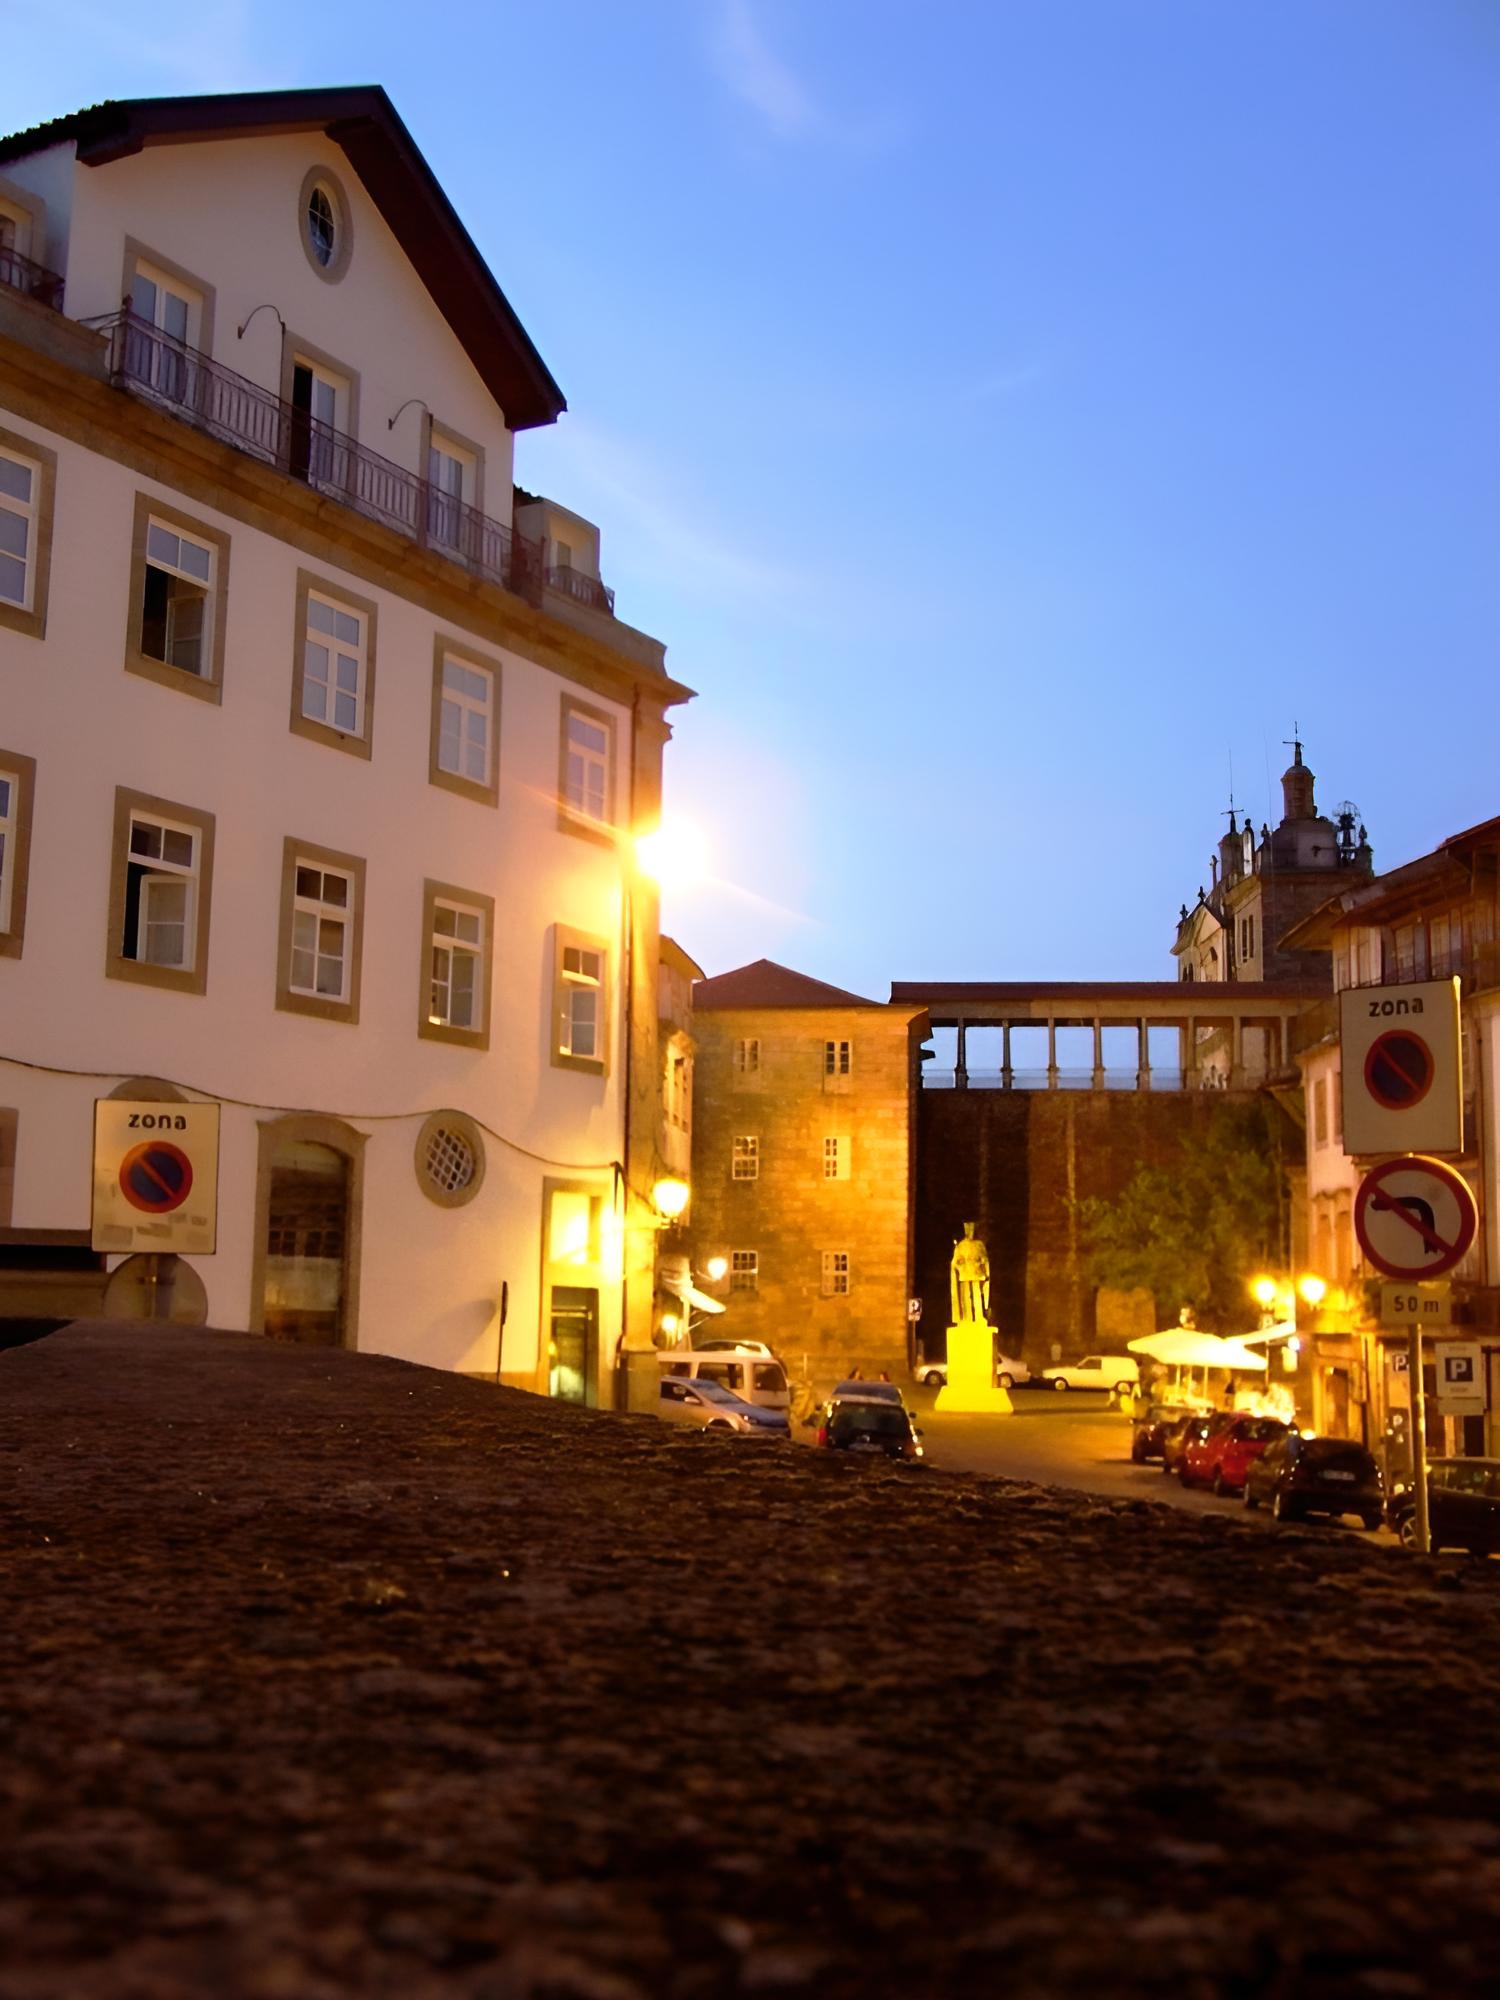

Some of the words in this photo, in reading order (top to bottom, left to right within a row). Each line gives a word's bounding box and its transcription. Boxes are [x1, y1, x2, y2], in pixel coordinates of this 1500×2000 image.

[1369, 998, 1424, 1017] zona
[128, 1113, 187, 1130] zona
[1394, 1296, 1418, 1312] 50
[1424, 1301, 1439, 1312] m
[1395, 1355, 1407, 1371] P
[1450, 1359, 1467, 1380] P
